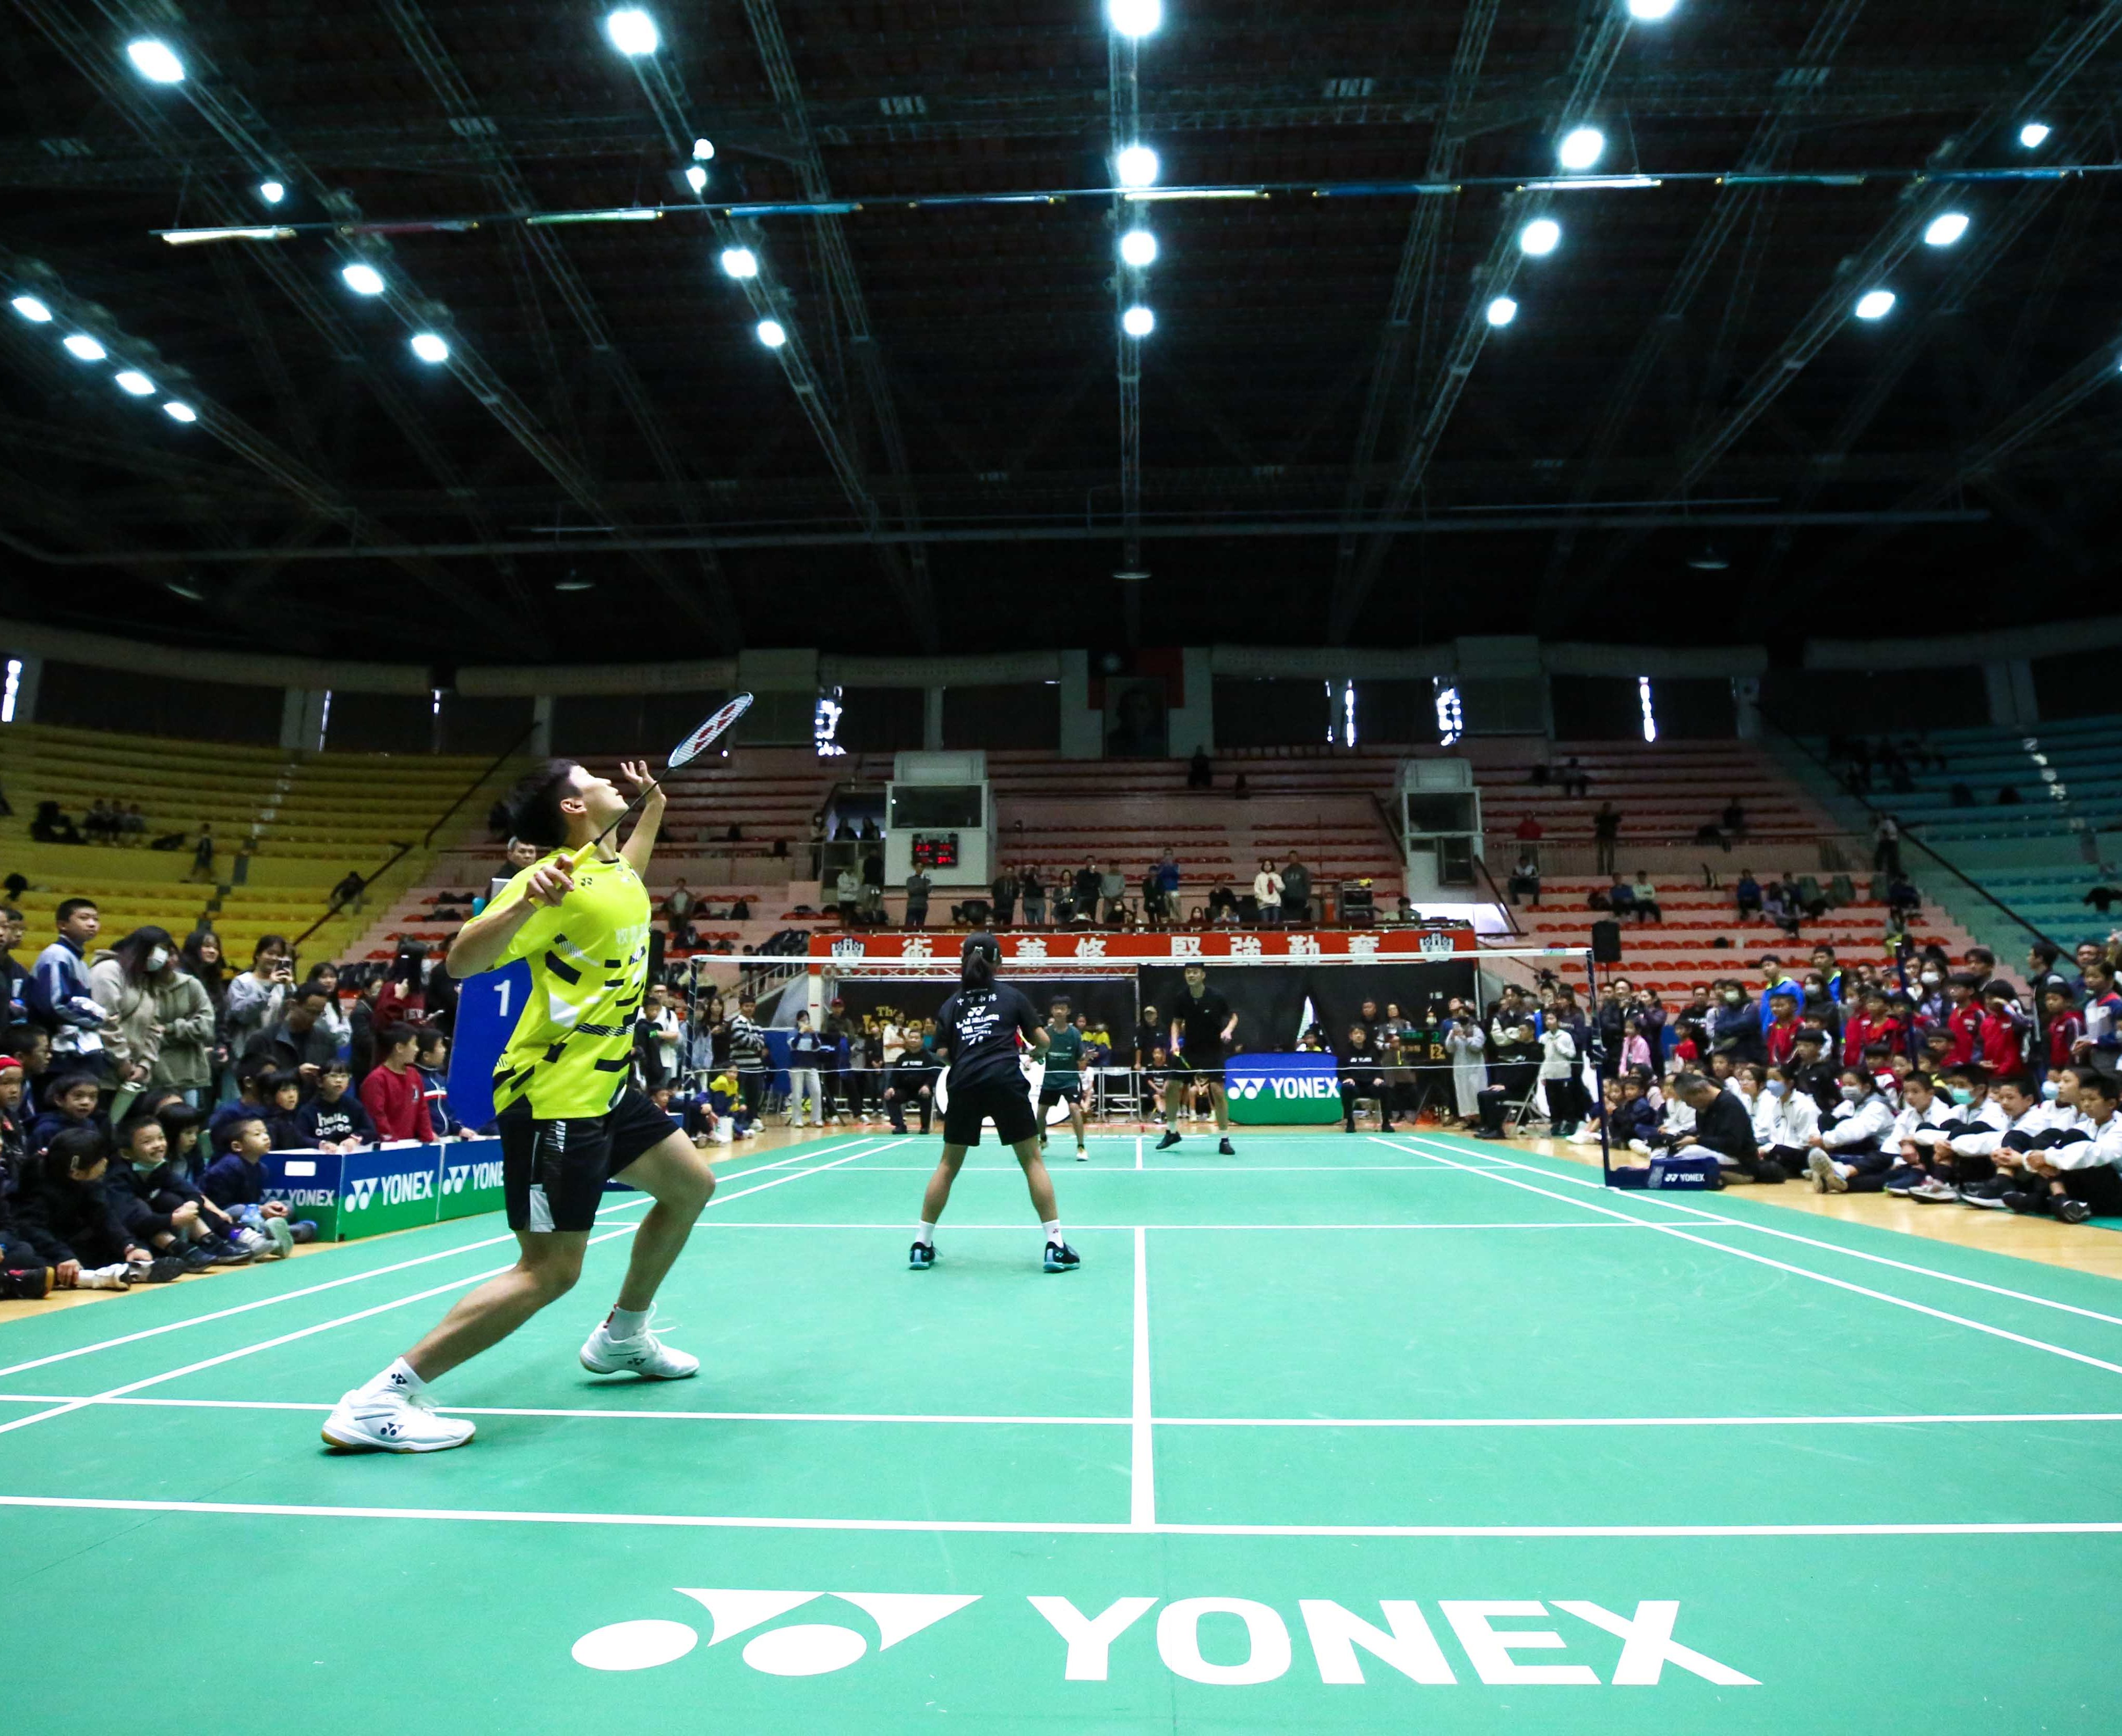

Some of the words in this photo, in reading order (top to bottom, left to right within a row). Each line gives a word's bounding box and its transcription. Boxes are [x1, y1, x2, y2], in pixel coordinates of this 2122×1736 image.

[494, 979, 510, 1017] 1
[1269, 1076, 1341, 1099] YONEX
[382, 1170, 434, 1205] YONEX
[472, 1160, 505, 1190] YONE
[1679, 1173, 1705, 1182] YONEX
[287, 1188, 335, 1207] YONEX
[1027, 1595, 1762, 1685] YONEX
